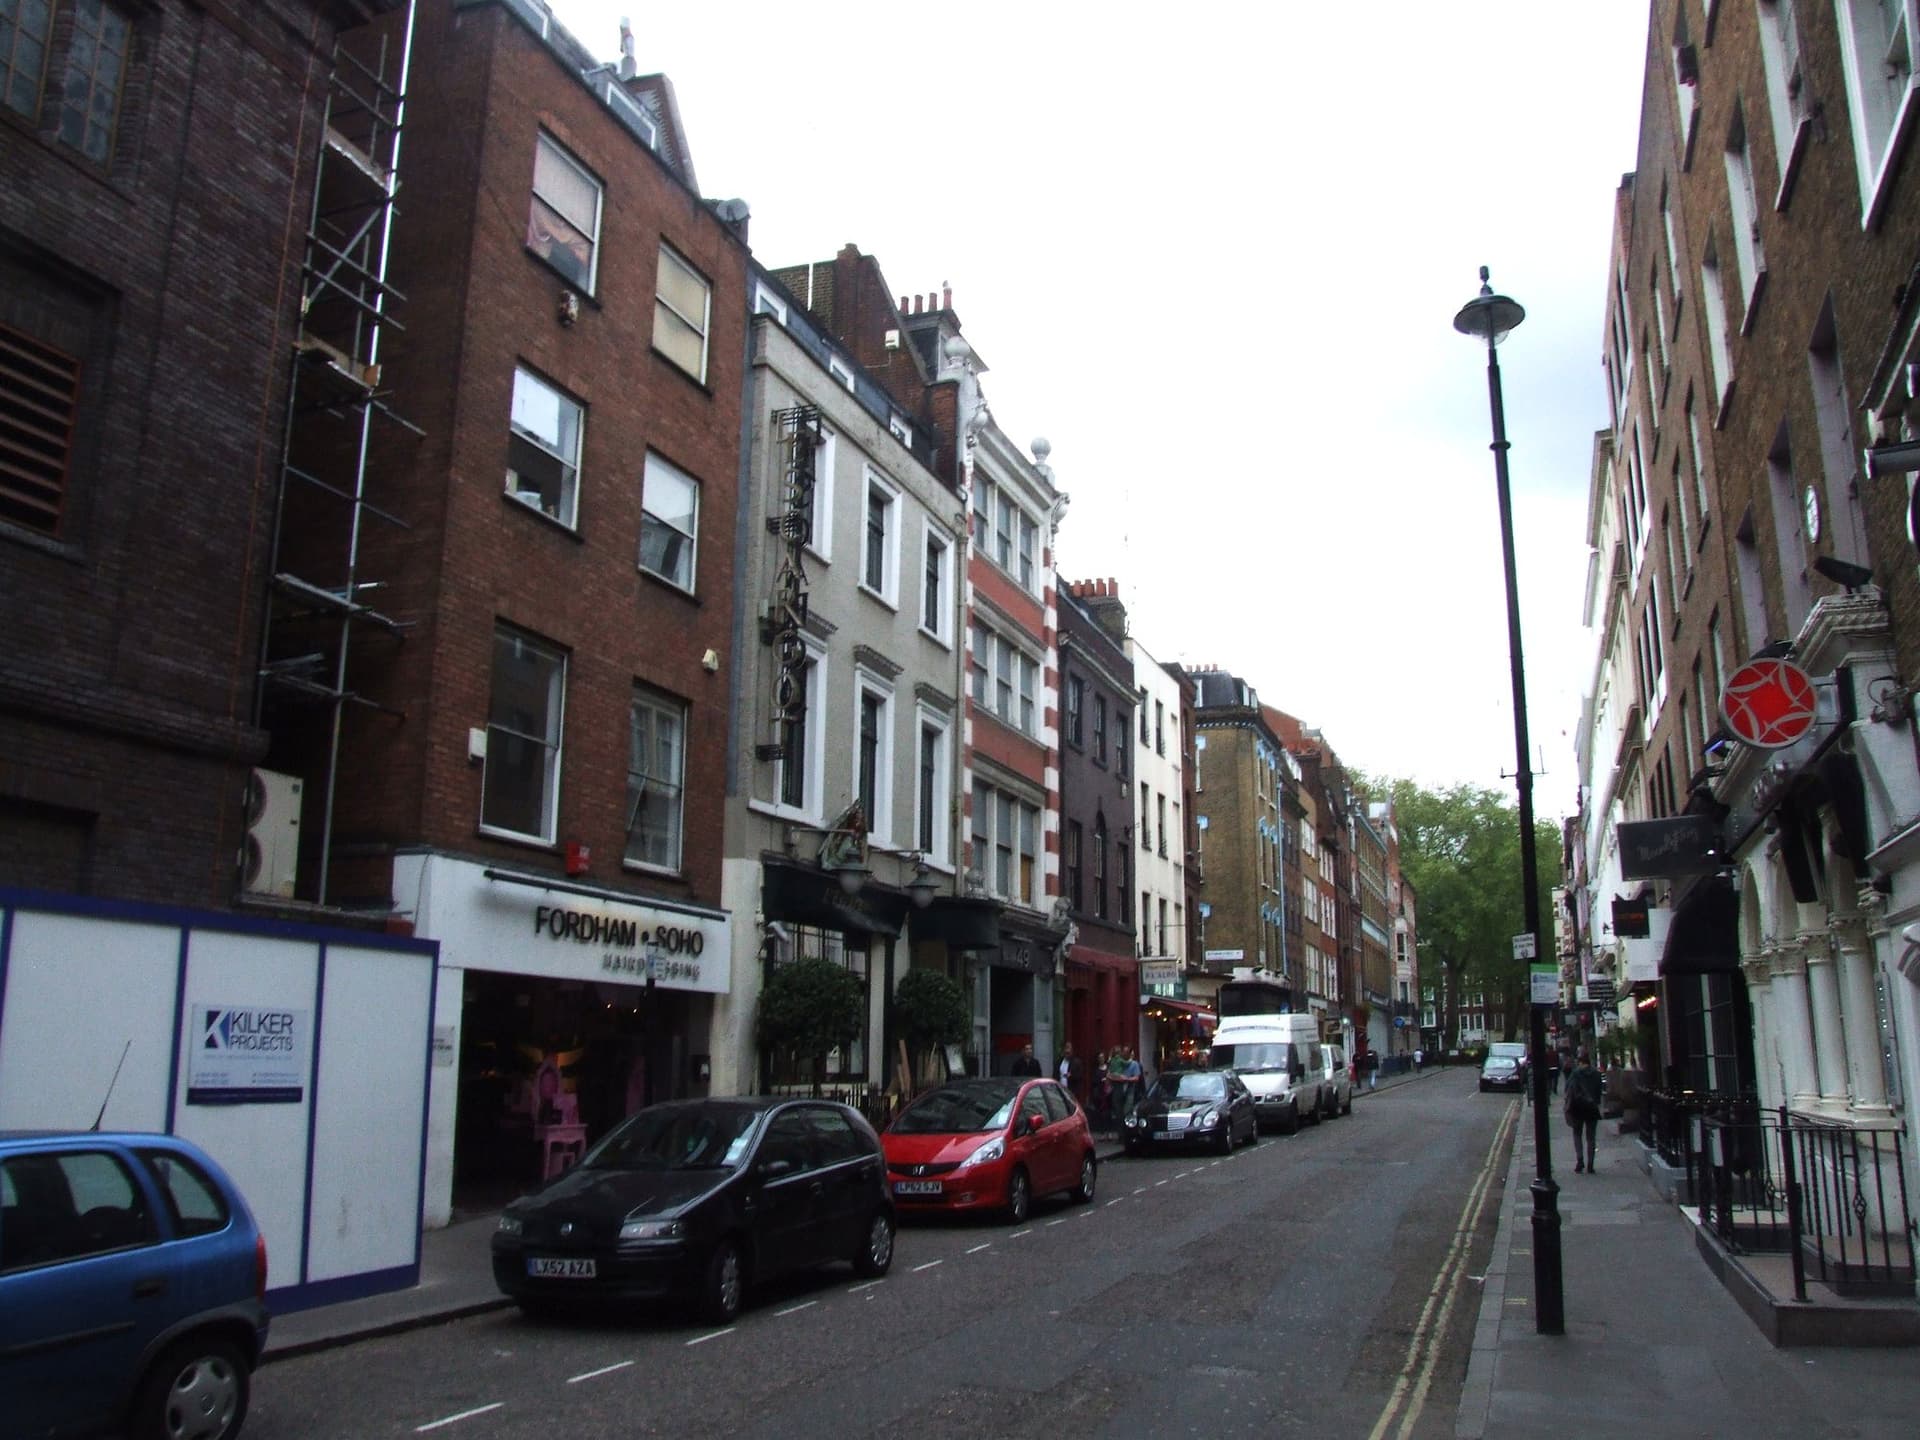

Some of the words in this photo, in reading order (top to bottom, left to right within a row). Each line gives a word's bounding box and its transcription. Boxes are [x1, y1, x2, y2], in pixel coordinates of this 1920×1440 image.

[535, 905, 636, 947] FORDHAM
[656, 925, 704, 957] SOHO
[231, 1011, 294, 1035] KILKER
[230, 1035, 294, 1051] PROJECTS
[535, 1260, 565, 1275] LX52
